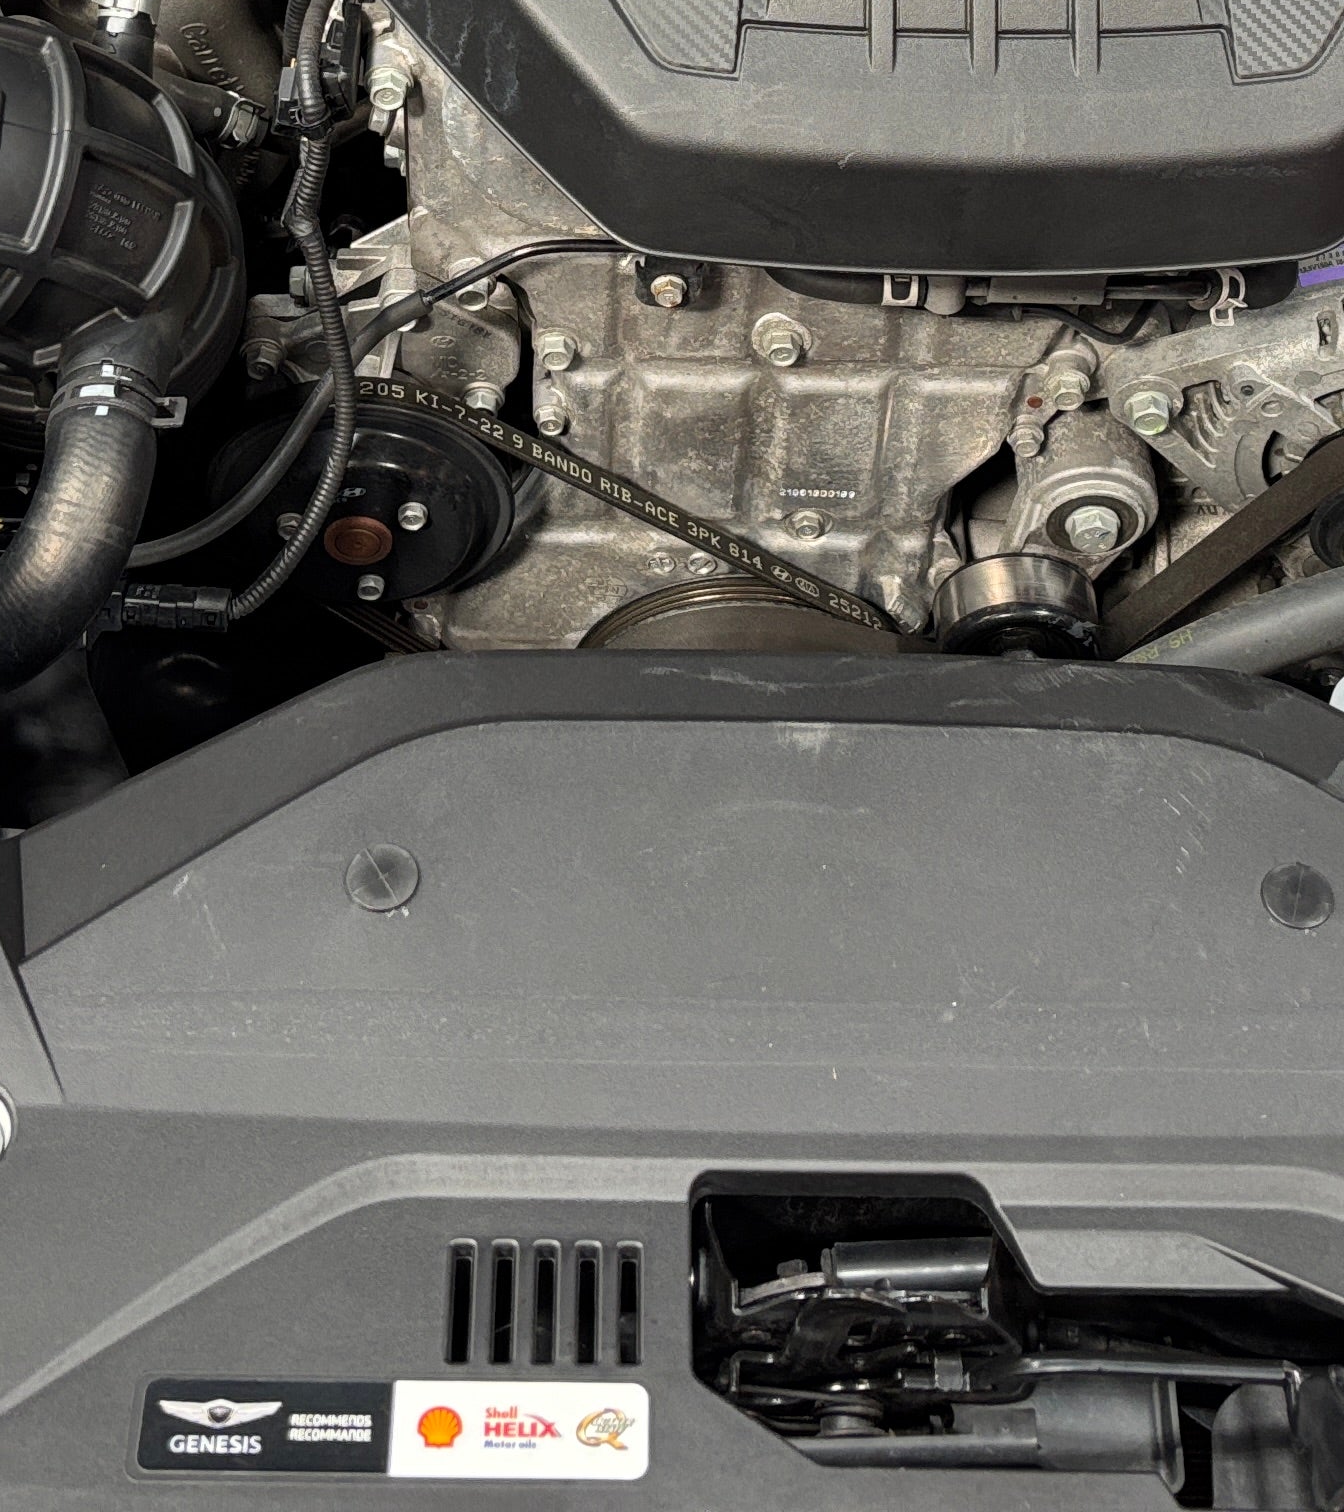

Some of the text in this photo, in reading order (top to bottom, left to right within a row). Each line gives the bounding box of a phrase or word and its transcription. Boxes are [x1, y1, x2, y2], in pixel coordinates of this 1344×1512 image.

[359, 382, 405, 399] 205
[531, 443, 593, 484] BANDO
[600, 478, 681, 529] RIB-ACE
[687, 521, 722, 550] 3PK
[729, 542, 764, 571] 814
[485, 1406, 518, 1419] Shell
[290, 1414, 372, 1428] RECOMMENDS
[288, 1428, 372, 1442] RECOMMANDE
[484, 1421, 560, 1439] HELIX
[169, 1434, 262, 1454] GENESIS
[483, 1439, 516, 1449] Motor
